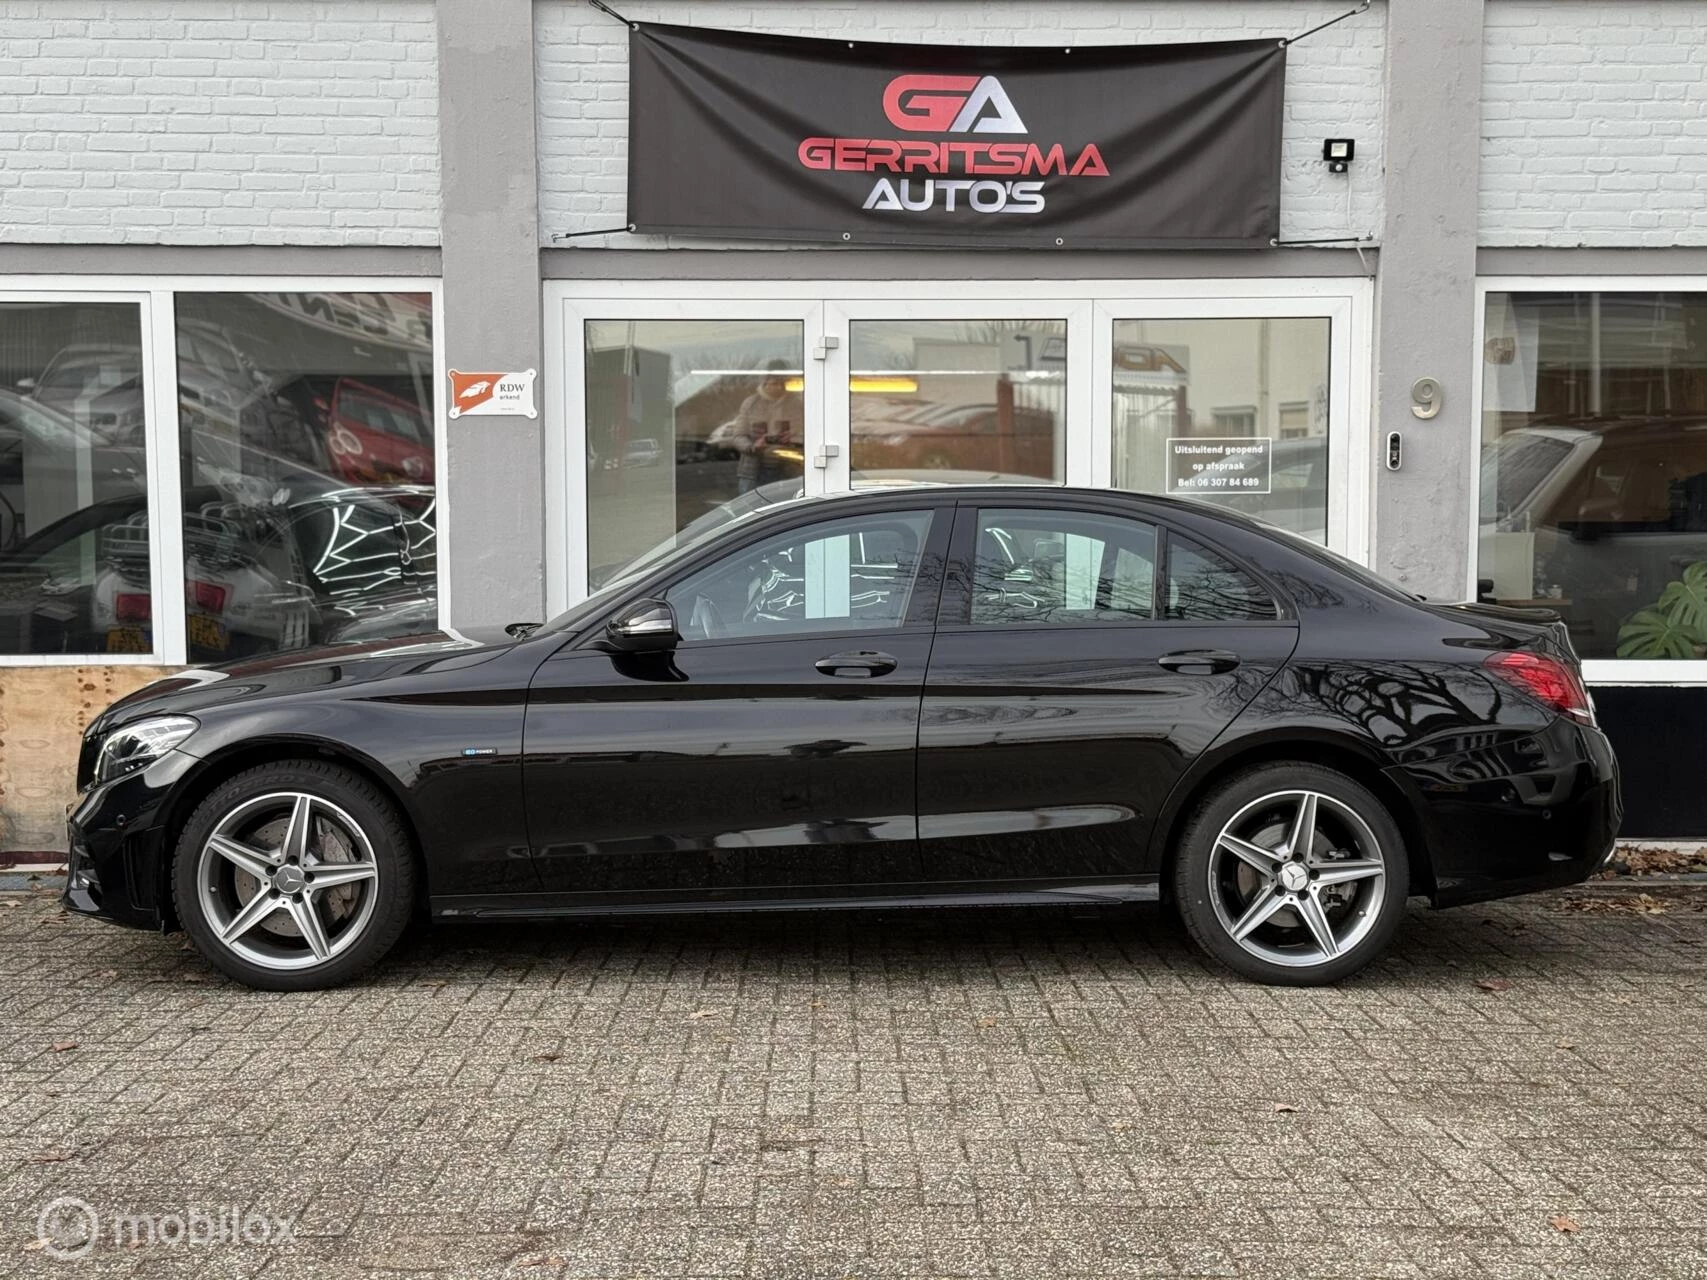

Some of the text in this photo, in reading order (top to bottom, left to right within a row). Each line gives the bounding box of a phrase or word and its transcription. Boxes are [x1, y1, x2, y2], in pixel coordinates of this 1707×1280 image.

[882, 74, 1028, 134] GA
[797, 137, 1110, 177] GERRITSMA
[862, 177, 1046, 214] AUTO'S
[500, 383, 525, 392] RDW
[1411, 376, 1442, 420] 9
[1174, 445, 1263, 455] Uitsluitend geopend
[1192, 462, 1245, 471] op afspraak
[1197, 479, 1208, 487] 06
[1210, 478, 1226, 486] 307
[1229, 478, 1240, 486] 84
[1242, 478, 1259, 486] 689
